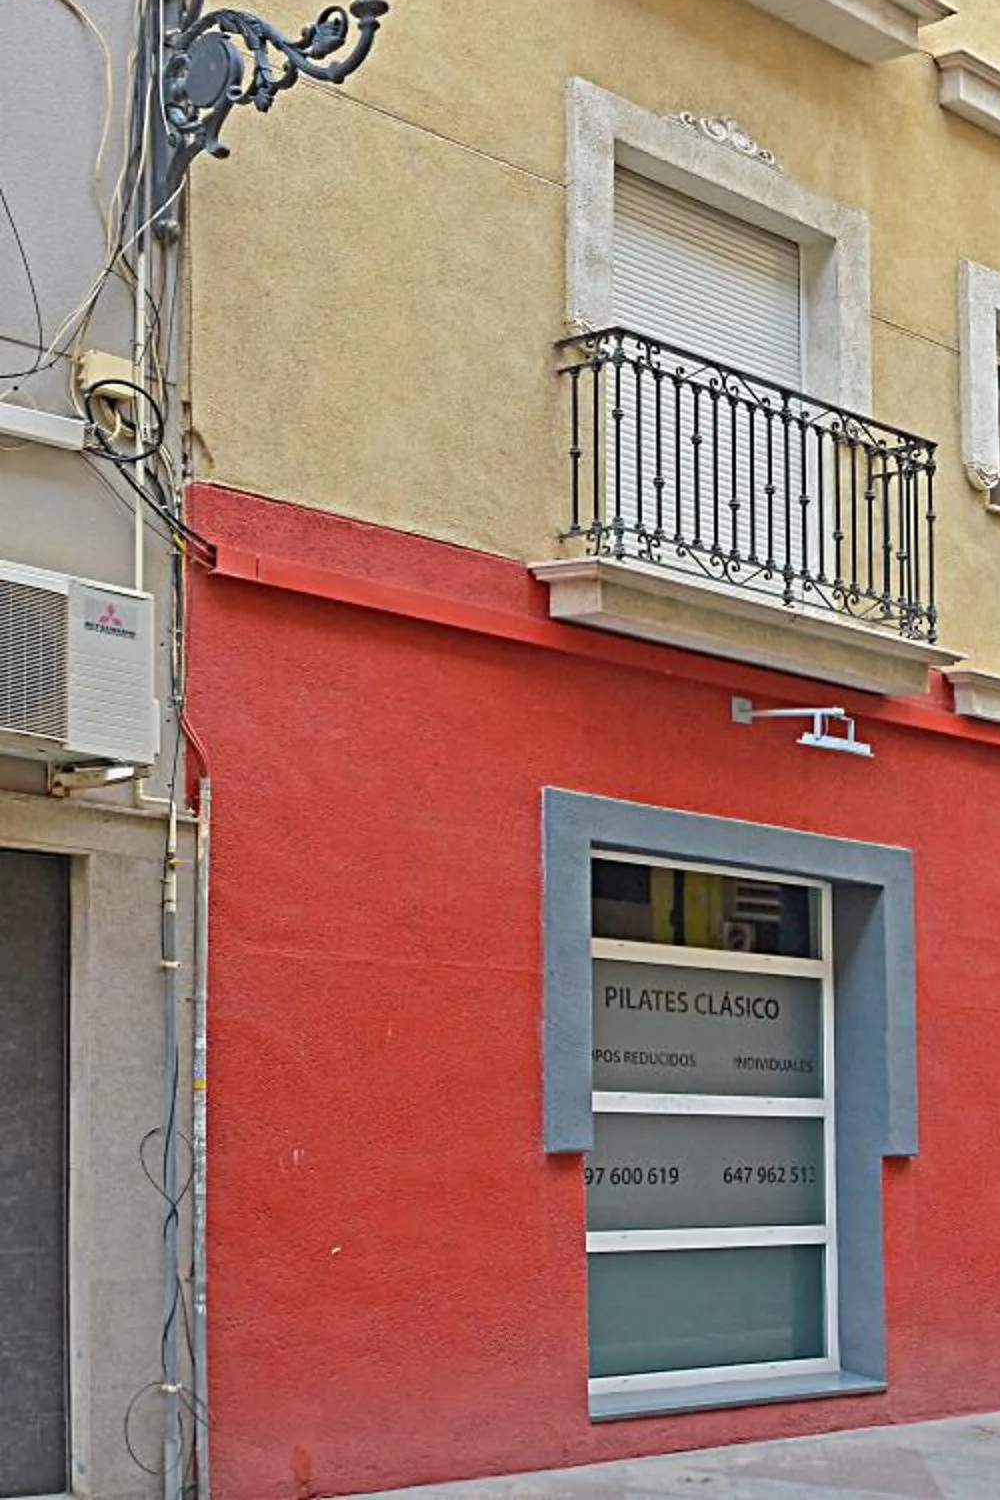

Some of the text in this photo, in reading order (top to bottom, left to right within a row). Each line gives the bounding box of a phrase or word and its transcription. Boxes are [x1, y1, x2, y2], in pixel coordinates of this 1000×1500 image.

[604, 986, 780, 1020] PILATES CLÁSICO
[592, 1049, 697, 1068] POS REDUCIDOS
[609, 1167, 643, 1185] 600
[647, 1167, 680, 1185] 619
[723, 1167, 753, 1184] 647
[757, 1165, 786, 1184] 962
